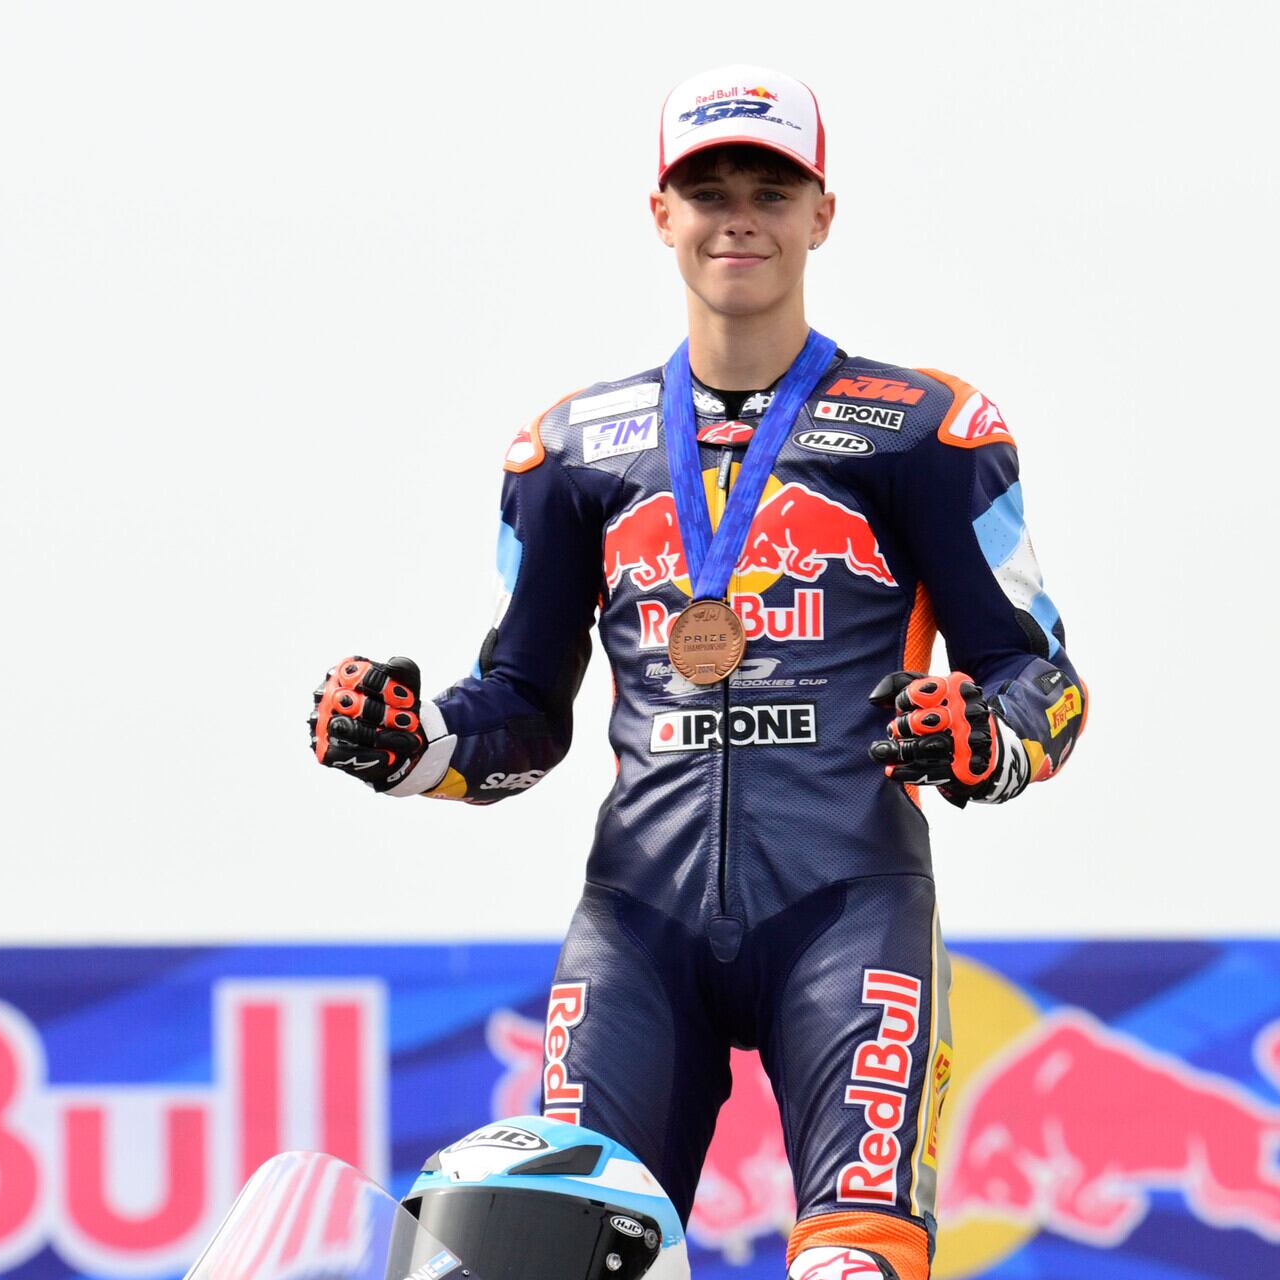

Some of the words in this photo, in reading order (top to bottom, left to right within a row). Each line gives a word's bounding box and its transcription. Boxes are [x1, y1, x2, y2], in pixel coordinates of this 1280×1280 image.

[695, 90, 716, 106] Red
[717, 87, 738, 99] Bull
[824, 376, 926, 405] KTM
[835, 405, 902, 430] IPONE
[593, 415, 654, 450] FIM
[803, 433, 866, 451] HJC
[730, 591, 821, 639] Bull
[684, 633, 728, 643] PRIZE
[645, 662, 678, 679] Mot
[732, 678, 795, 687] ROOKIES
[799, 678, 828, 686] CUP
[681, 708, 812, 746] IPONE
[547, 986, 583, 1100] Red
[855, 972, 919, 1085] Bull
[840, 1088, 903, 1202] Red
[616, 1219, 640, 1233] HJC
